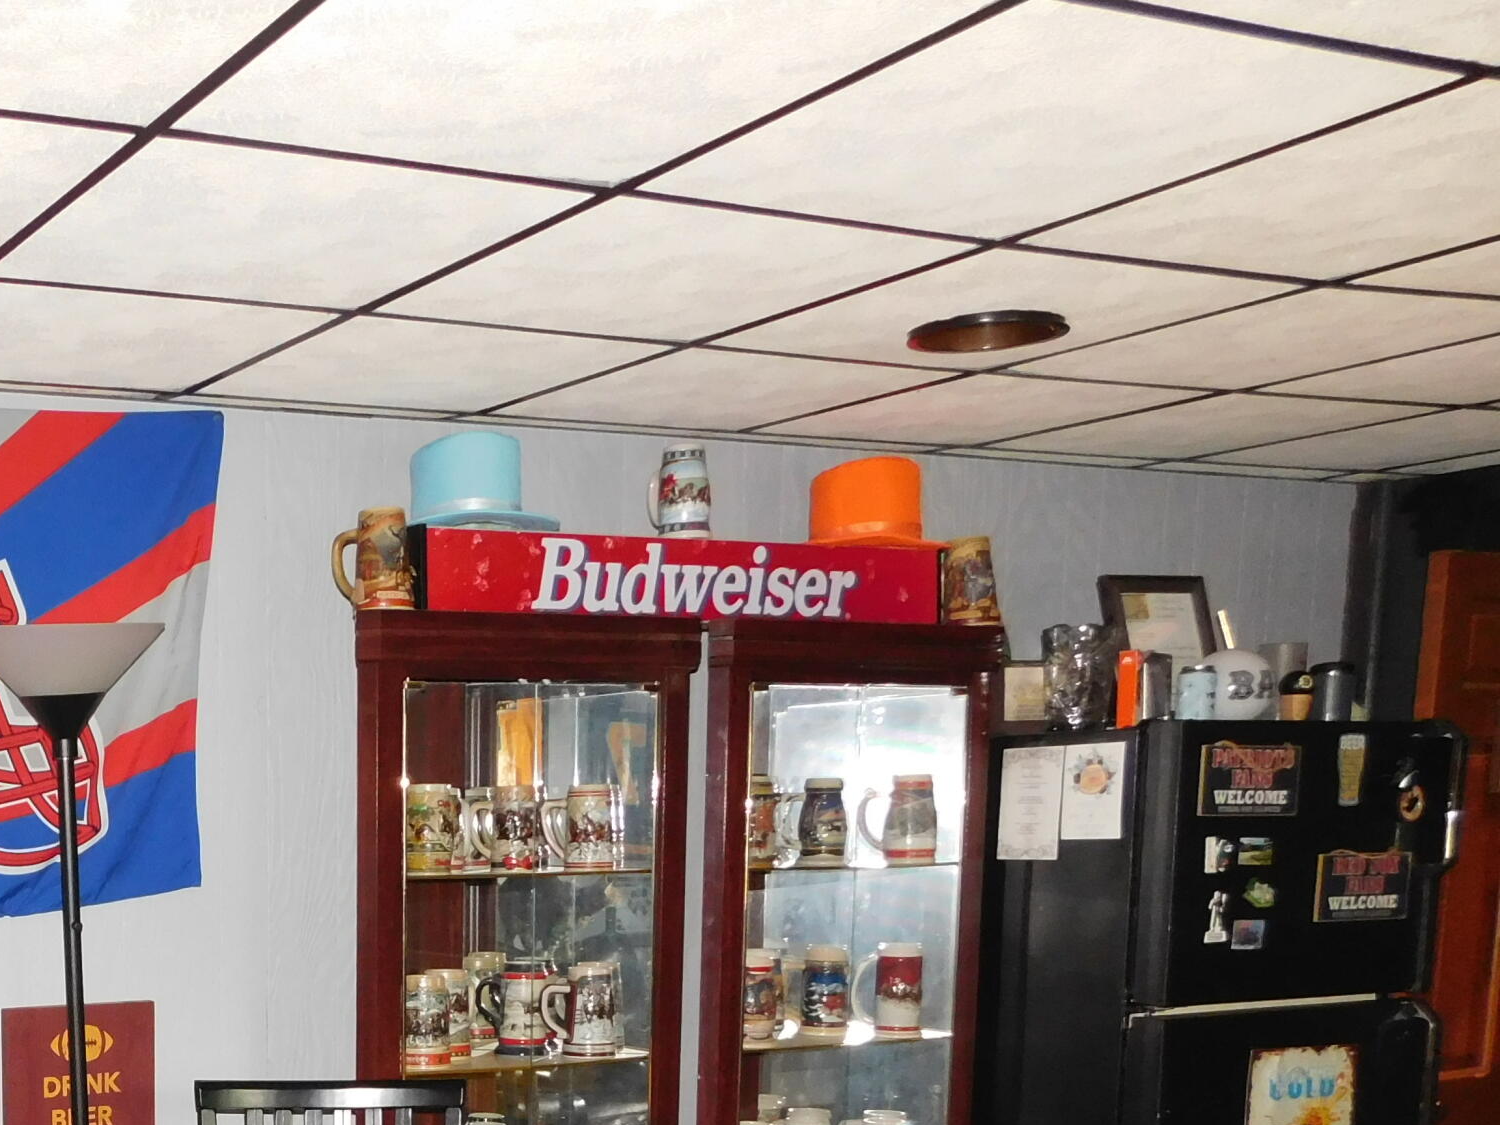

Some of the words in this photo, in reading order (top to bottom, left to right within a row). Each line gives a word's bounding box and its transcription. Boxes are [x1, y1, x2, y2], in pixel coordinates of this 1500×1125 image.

[531, 537, 857, 618] Budweiser
[1213, 789, 1288, 805] WELCOME
[1328, 894, 1399, 911] WELCOME
[43, 1071, 121, 1099] DRNK
